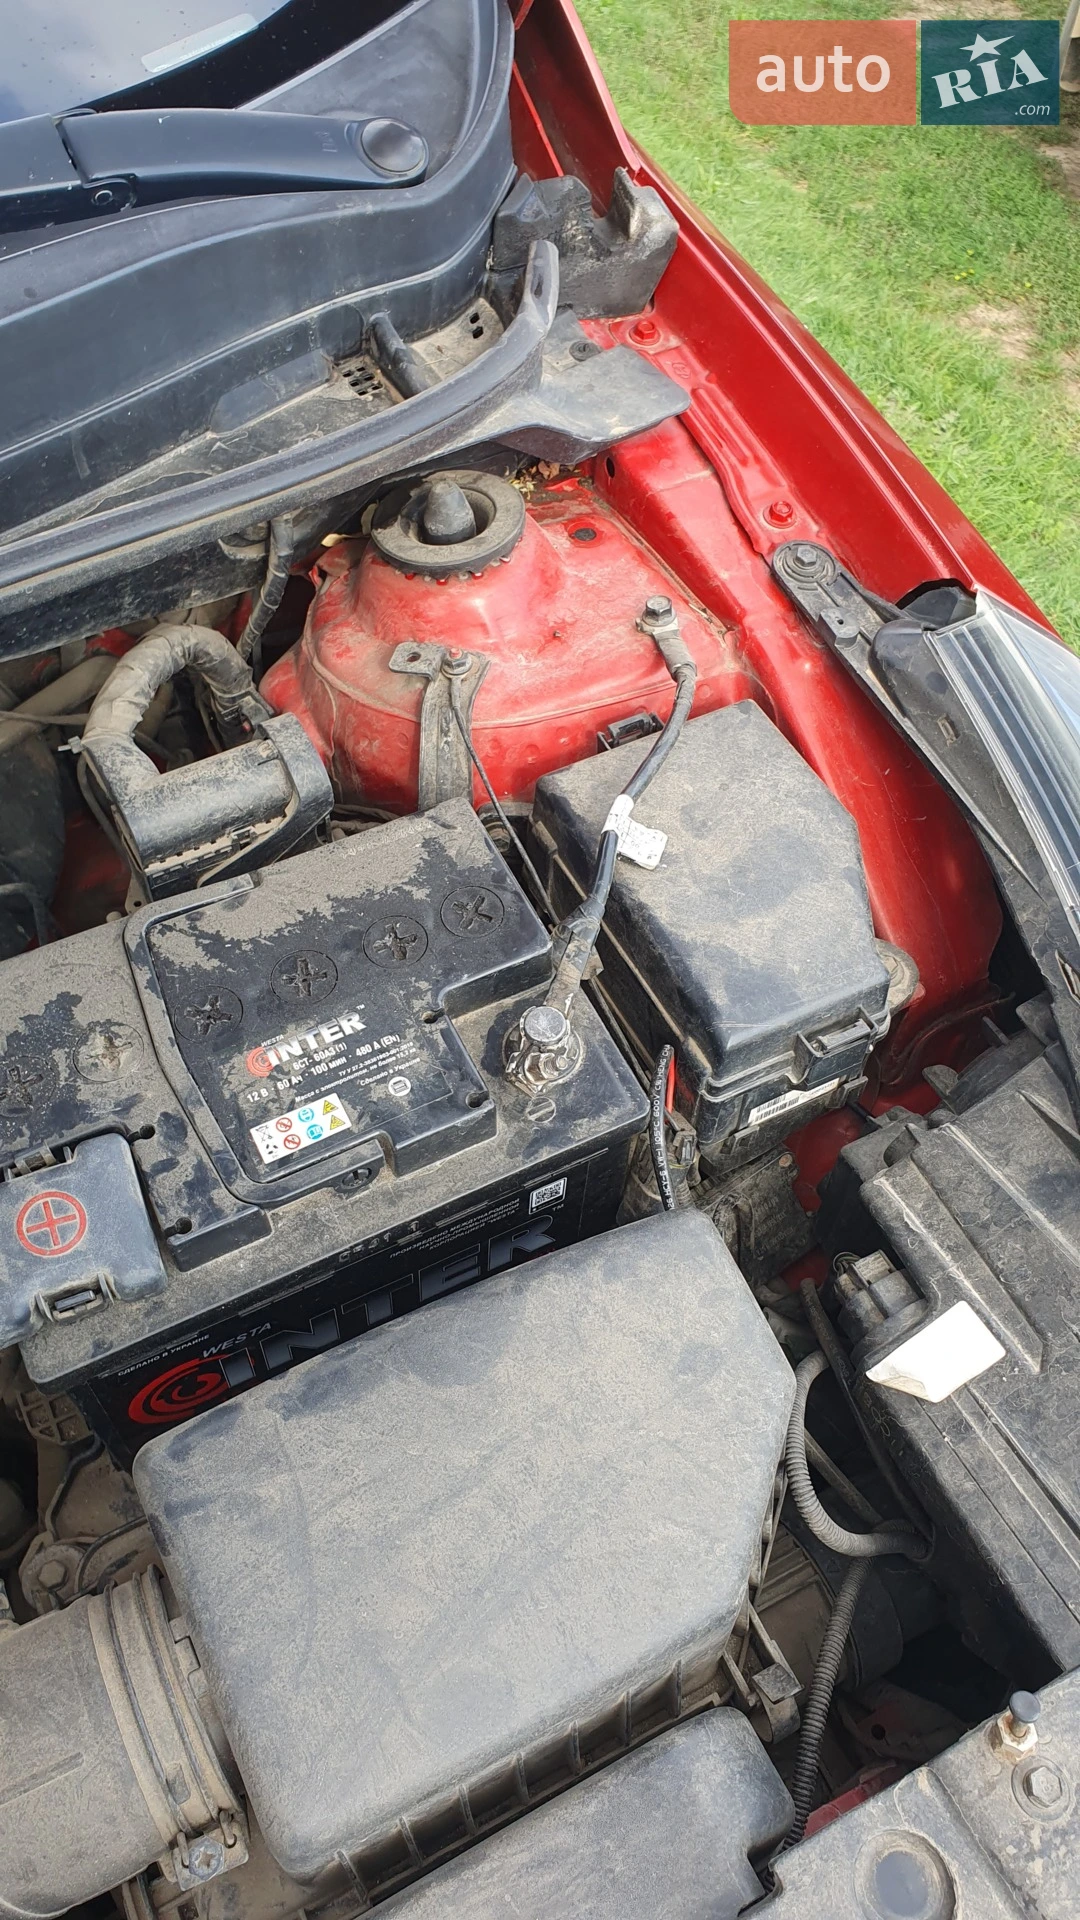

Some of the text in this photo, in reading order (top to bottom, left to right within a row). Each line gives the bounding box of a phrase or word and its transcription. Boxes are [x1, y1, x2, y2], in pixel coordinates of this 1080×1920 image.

[260, 1034, 284, 1048] WESTA
[263, 1012, 367, 1067] INTER
[246, 1091, 260, 1103] 12
[277, 1079, 290, 1091] 60
[310, 1063, 328, 1076] 100
[330, 1056, 347, 1069] мин
[355, 1044, 372, 1057] 480
[360, 1070, 388, 1086] Сделано
[652, 1094, 662, 1117] 600V
[219, 1214, 556, 1389] INTER
[117, 1355, 160, 1376] СДЕЛАНО
[170, 1334, 210, 1354] УКРАИНЕ
[202, 1321, 273, 1358] WESTA
